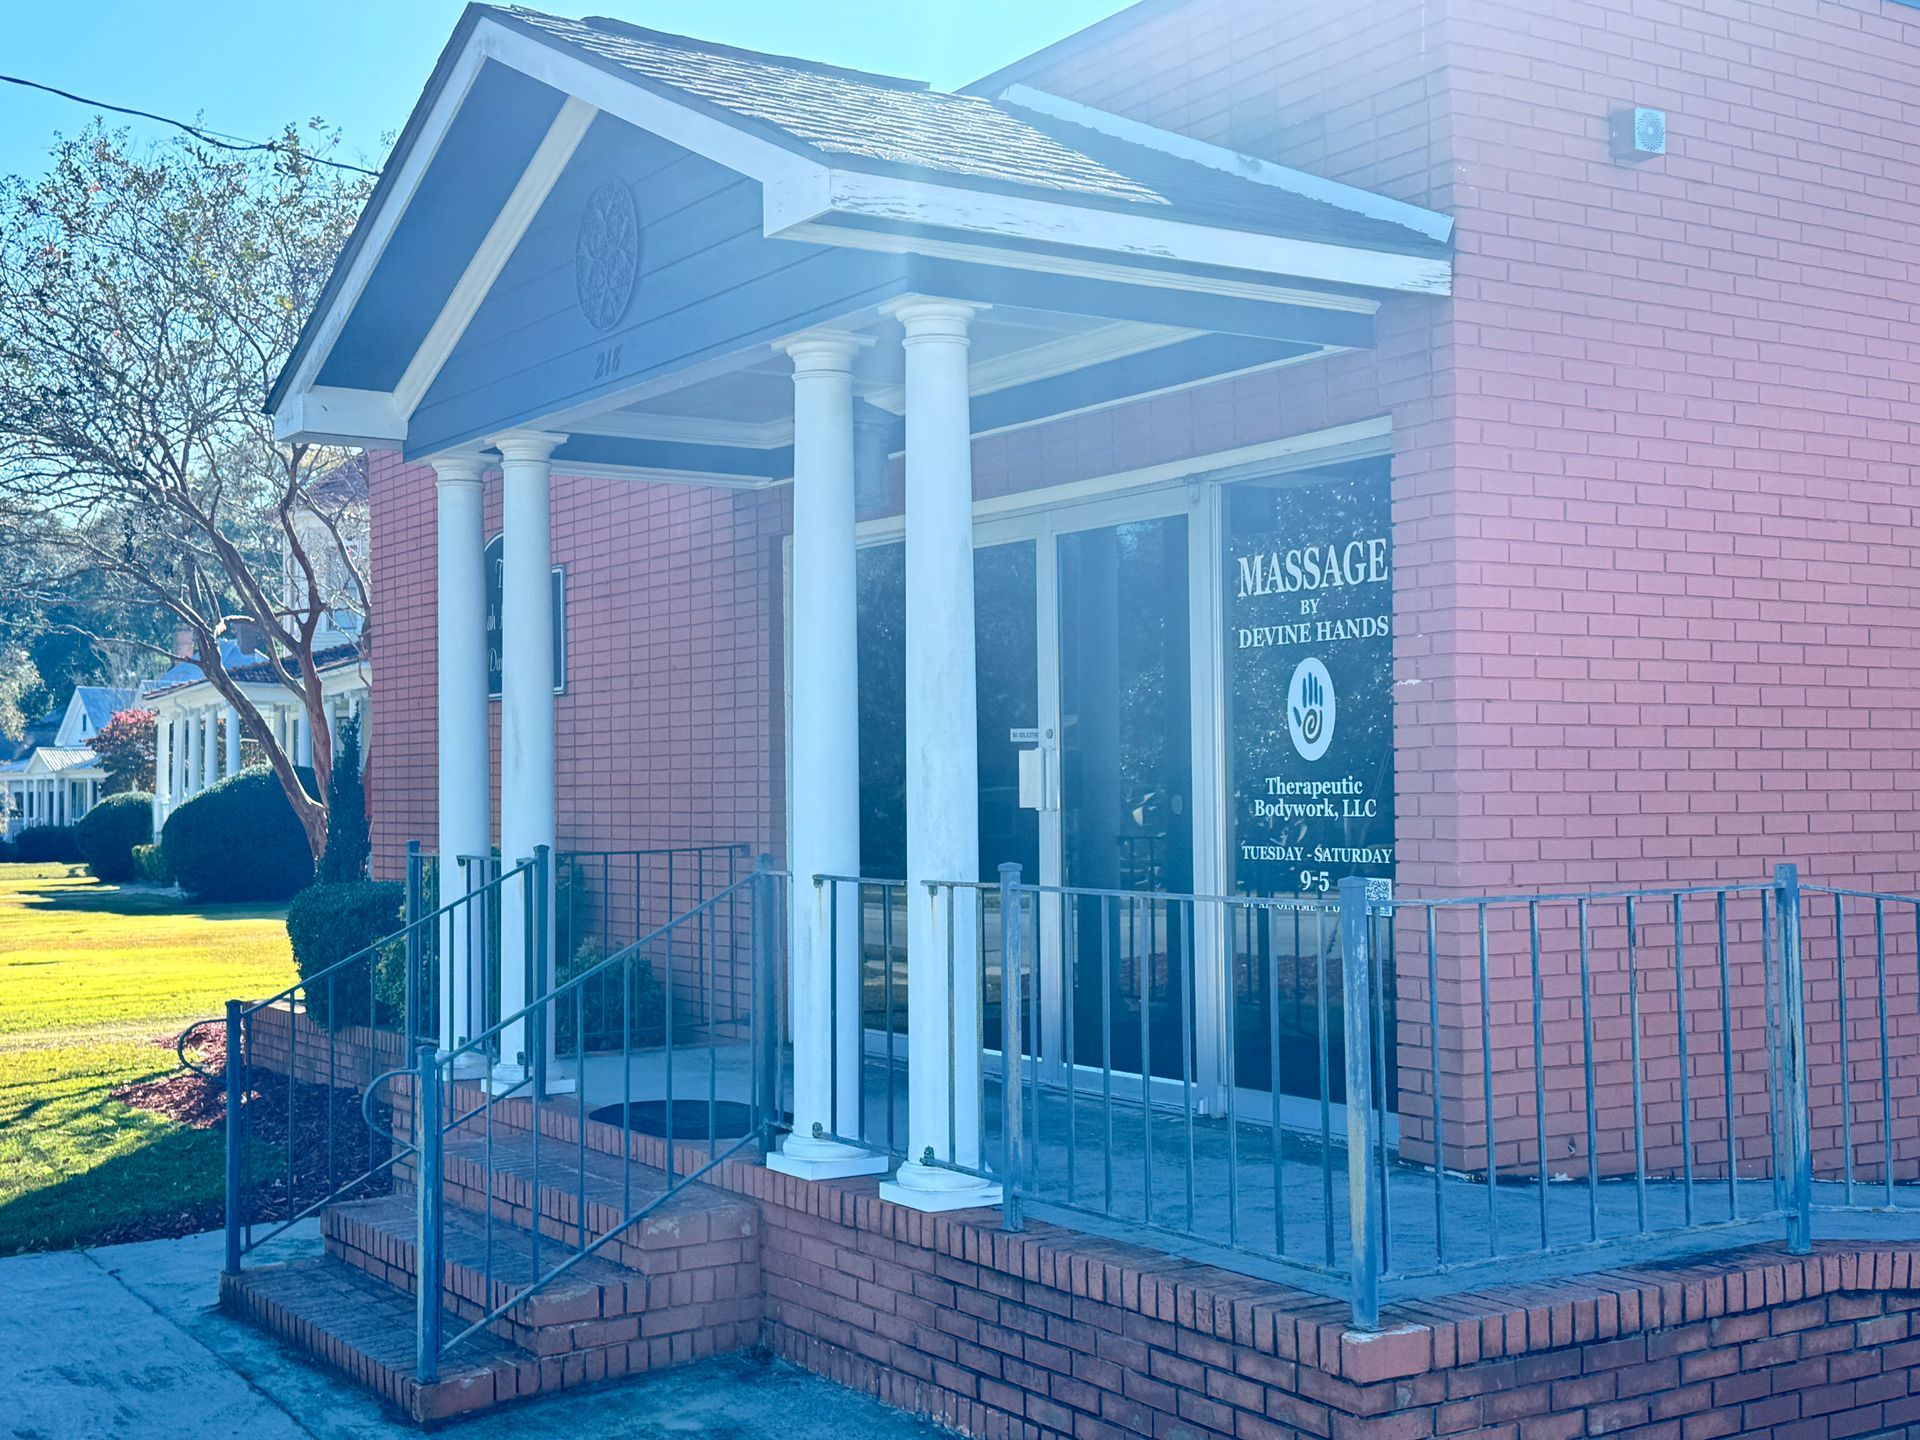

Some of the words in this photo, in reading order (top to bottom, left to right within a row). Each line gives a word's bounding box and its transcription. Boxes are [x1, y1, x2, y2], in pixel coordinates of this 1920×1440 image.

[1237, 538, 1388, 597] MASSAGE
[1300, 598, 1320, 615] BY
[1238, 622, 1312, 648] DEVINE
[1315, 615, 1389, 641] HANDS
[1265, 775, 1363, 799] Therapeutic
[1254, 798, 1339, 821] Bodywork,
[1342, 799, 1377, 818] LLC
[1241, 846, 1304, 861] TUESDAY
[1314, 847, 1393, 864] SATURDAY
[1300, 870, 1330, 892] 9-5
